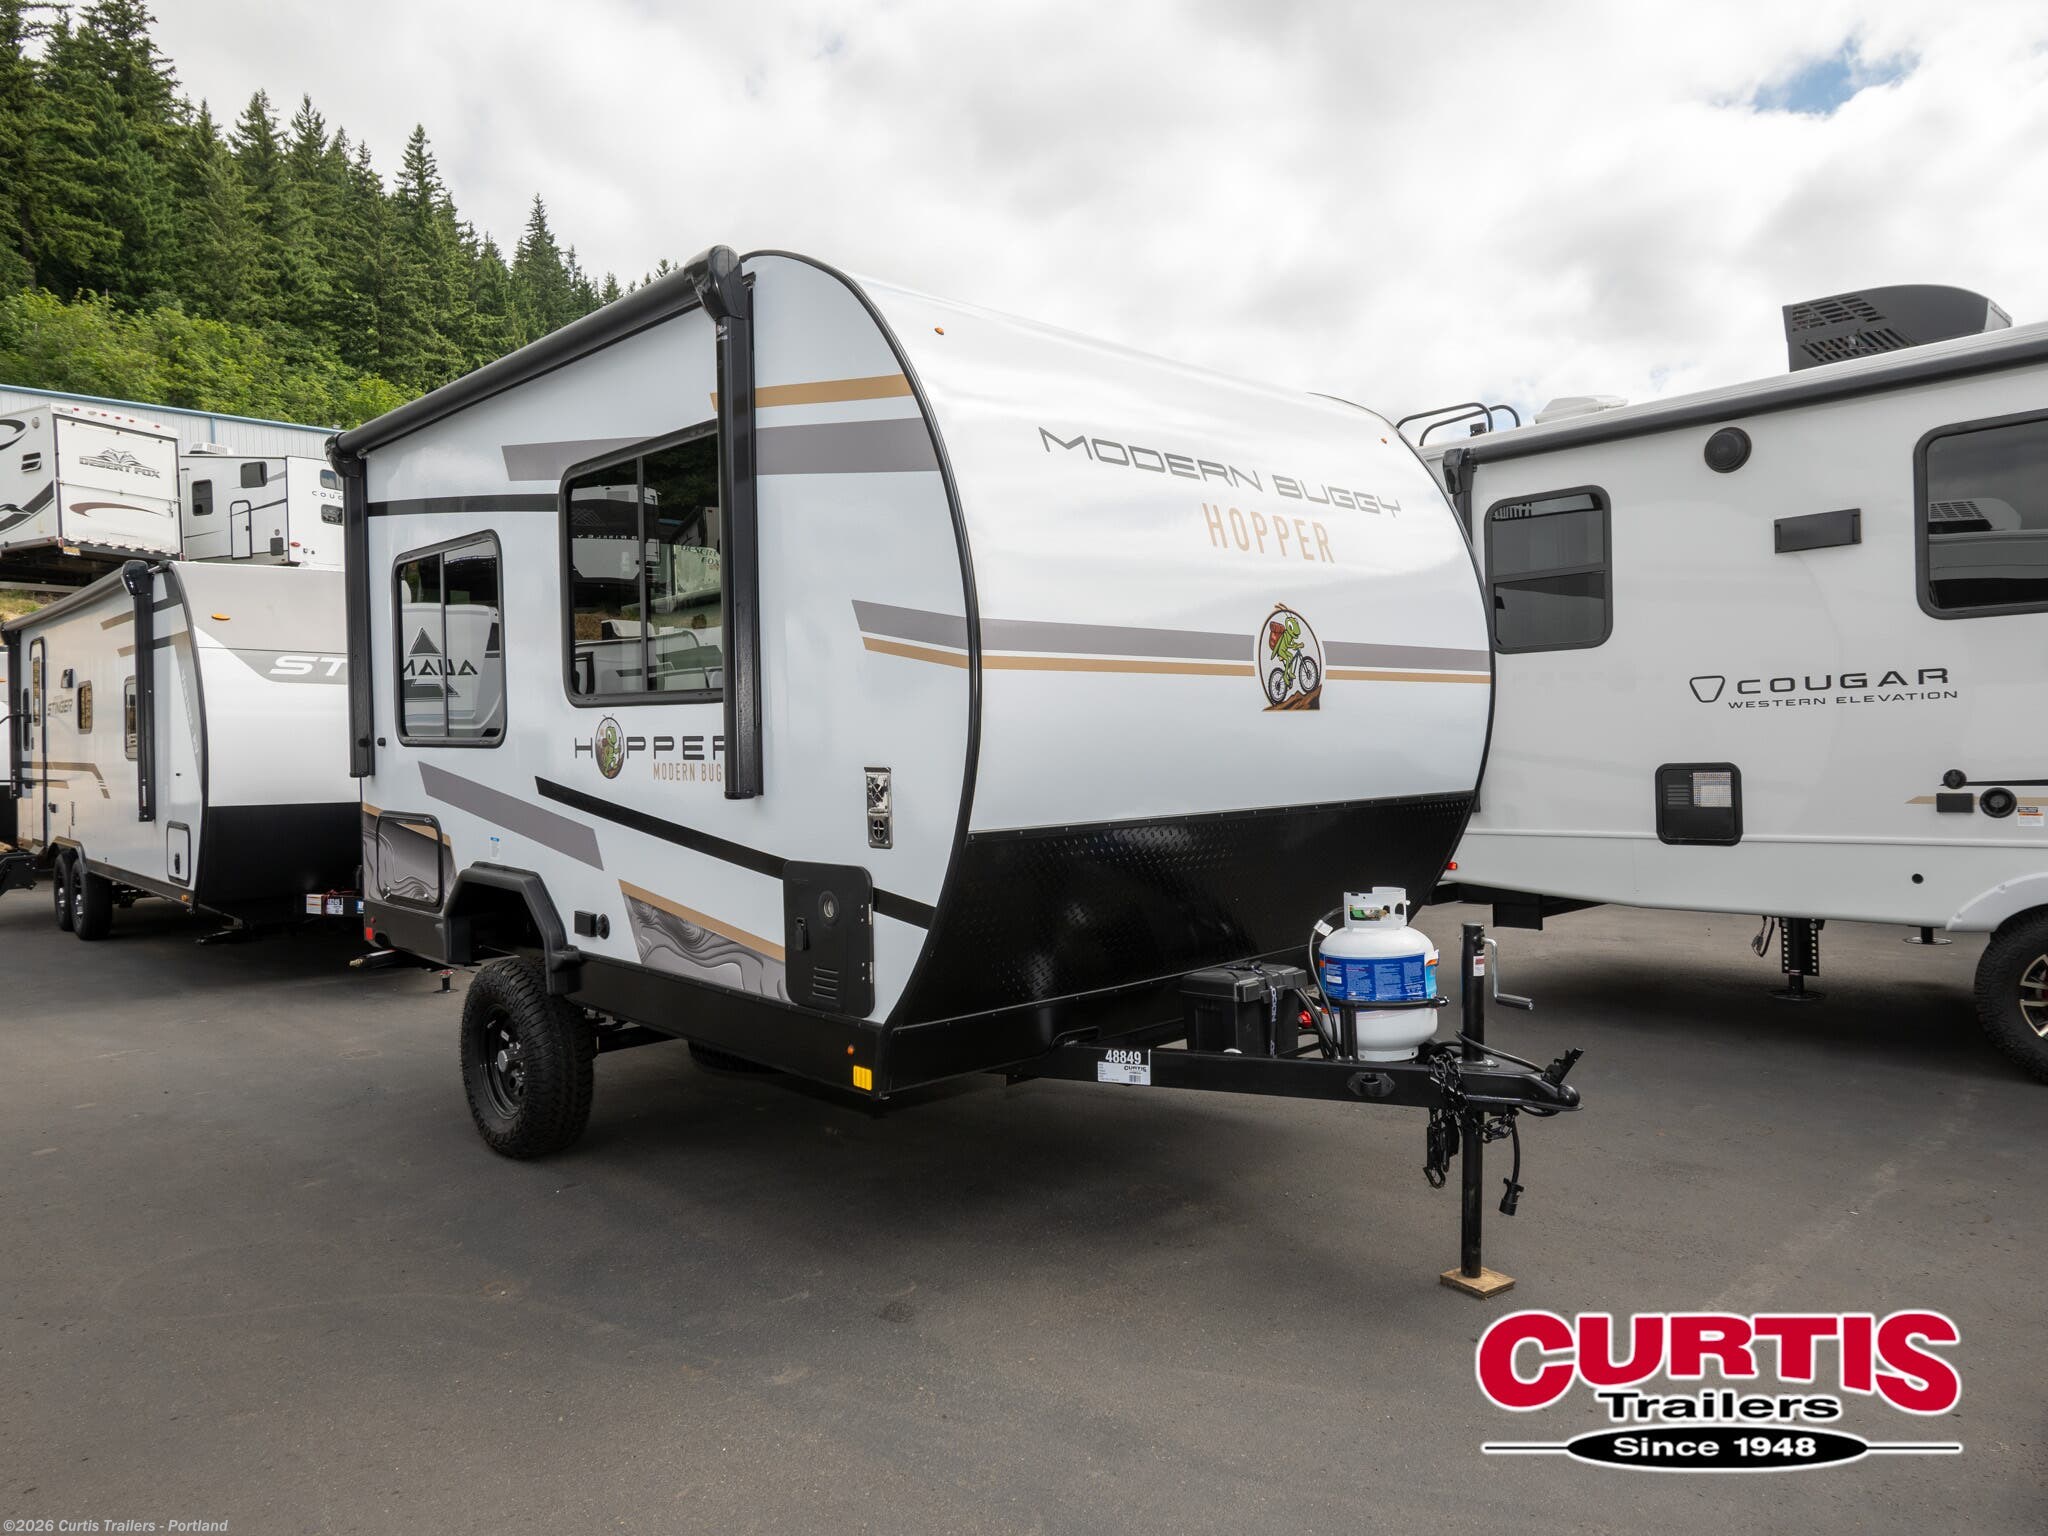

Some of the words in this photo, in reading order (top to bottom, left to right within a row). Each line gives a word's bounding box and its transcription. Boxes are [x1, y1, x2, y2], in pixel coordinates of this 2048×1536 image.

[1039, 426, 1263, 492] MODERN
[1272, 474, 1401, 518] BUGGY
[1202, 502, 1335, 564] HOPPER
[1737, 667, 1949, 696] COUGAR
[1728, 696, 1827, 709] WESTERN
[1836, 690, 1959, 704] ELEVATION
[653, 762, 696, 781] MODERN
[1105, 1049, 1142, 1065] 48849
